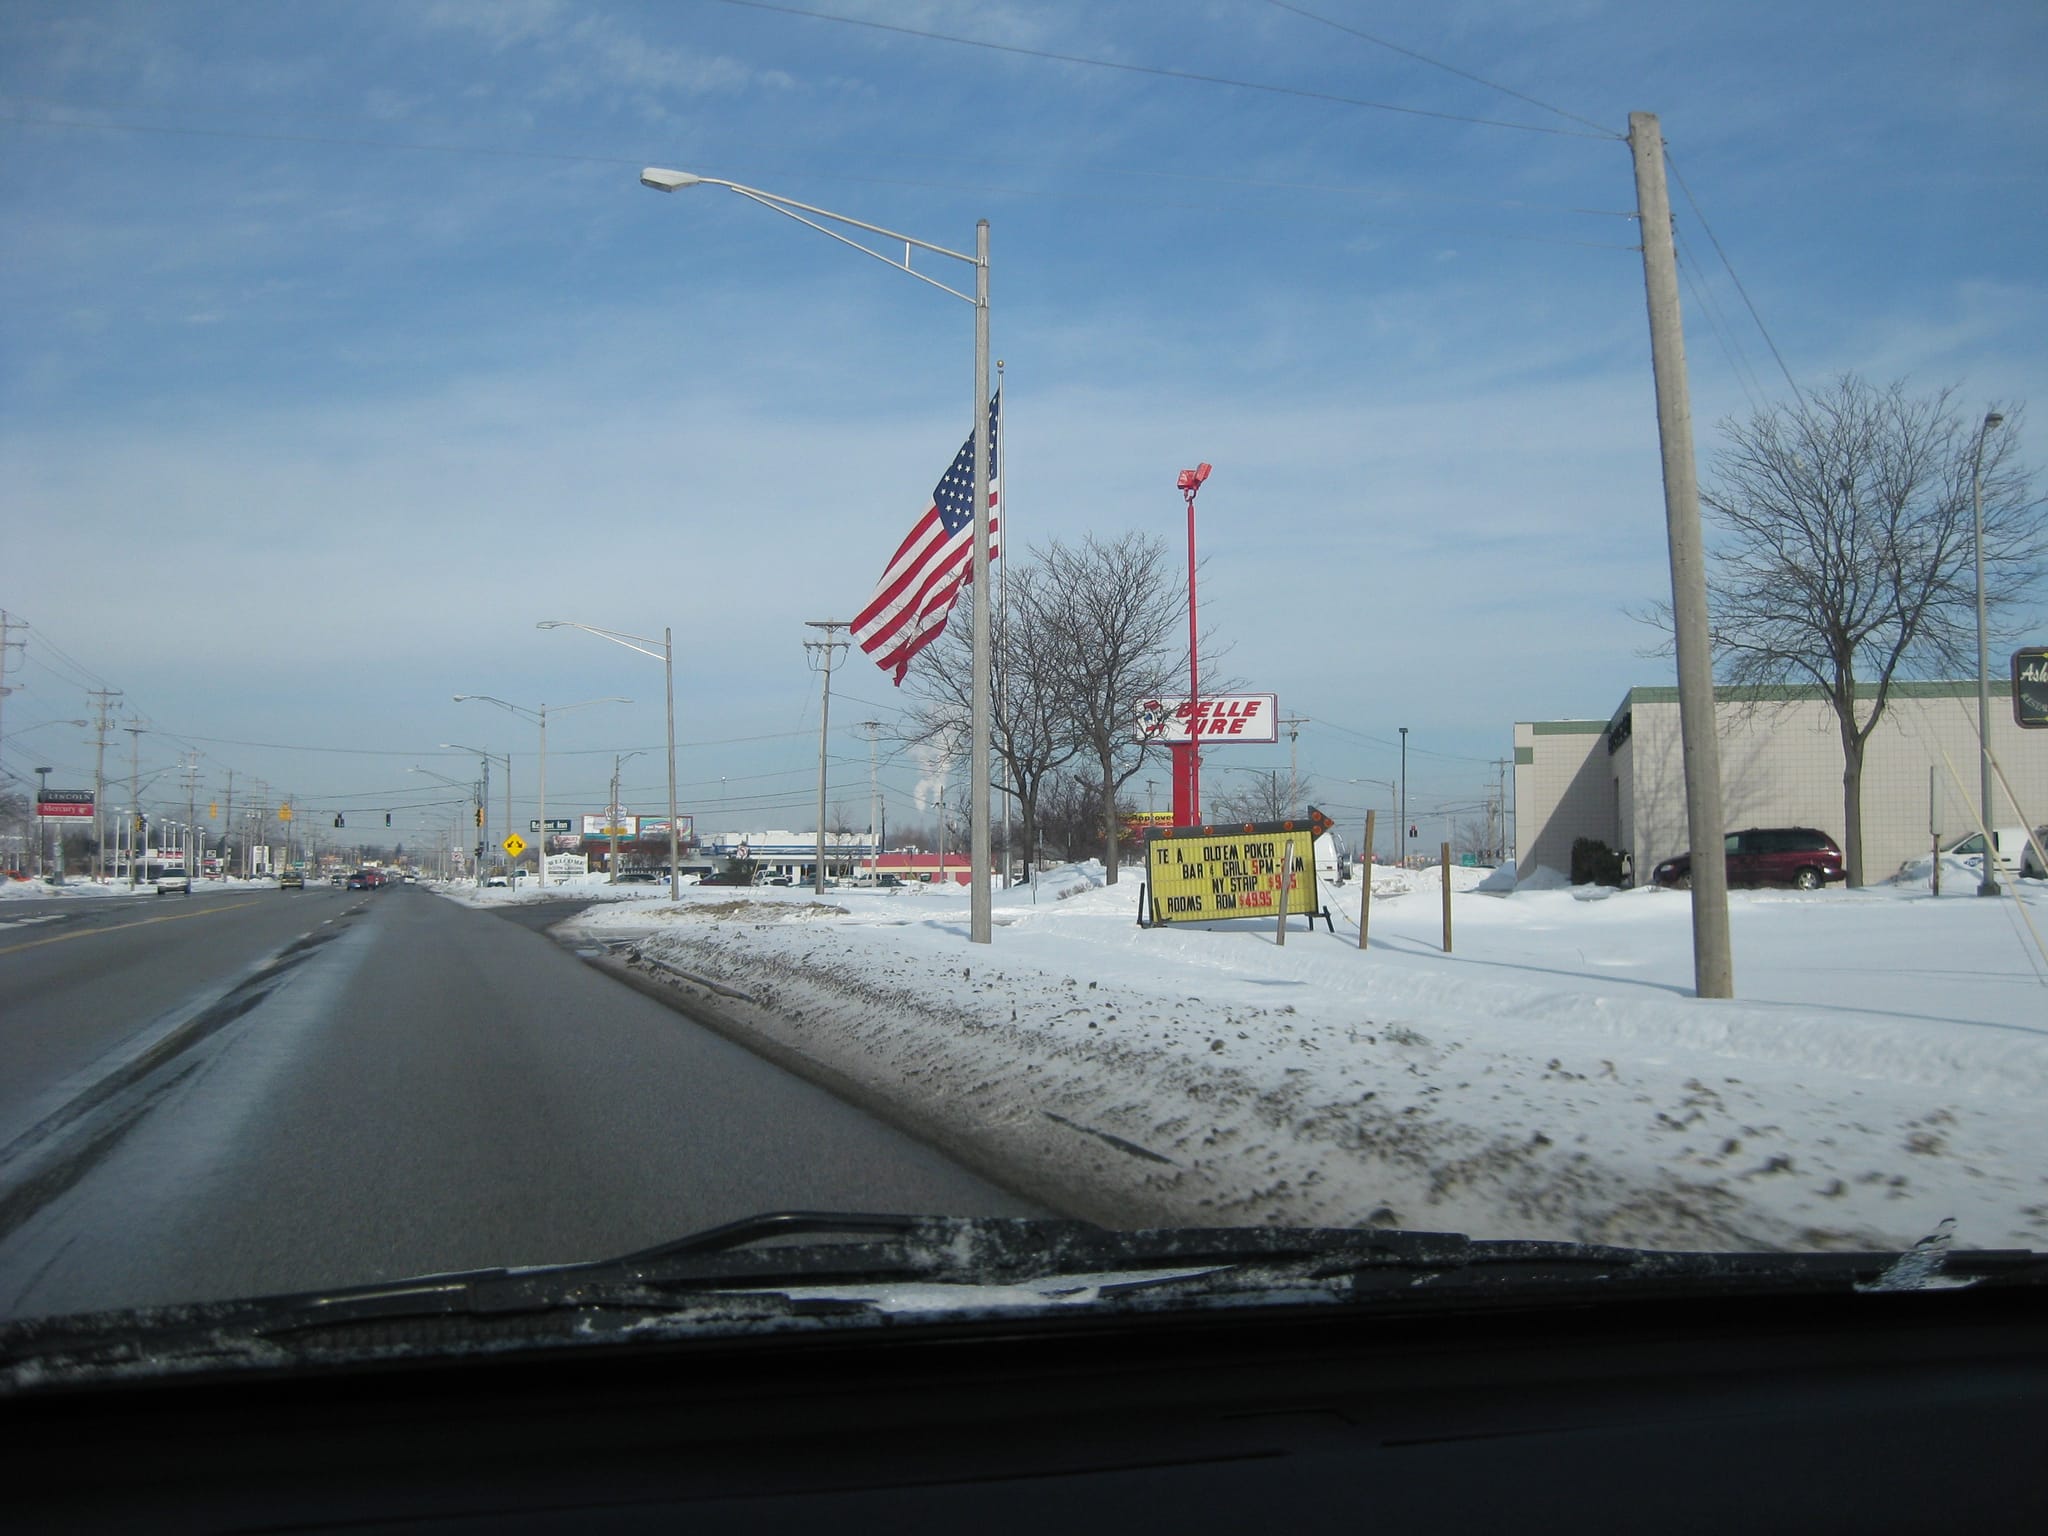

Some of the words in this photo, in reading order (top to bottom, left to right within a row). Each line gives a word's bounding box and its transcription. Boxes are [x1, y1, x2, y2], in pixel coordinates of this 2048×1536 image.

[1175, 701, 1262, 718] BELLE
[1184, 718, 1248, 735] TIRE
[531, 821, 555, 829] Reent
[557, 820, 568, 829] Inn
[548, 858, 584, 866] WELCOME
[1157, 848, 1169, 864] TE
[1177, 847, 1184, 864] A
[1244, 842, 1275, 859] POKER
[1182, 863, 1204, 880] BAR
[1222, 859, 1249, 877] GRILL
[1212, 877, 1225, 894] NY
[1230, 875, 1258, 893] STRIP
[1167, 896, 1202, 913] ROOMS
[1216, 893, 1237, 910] ROM
